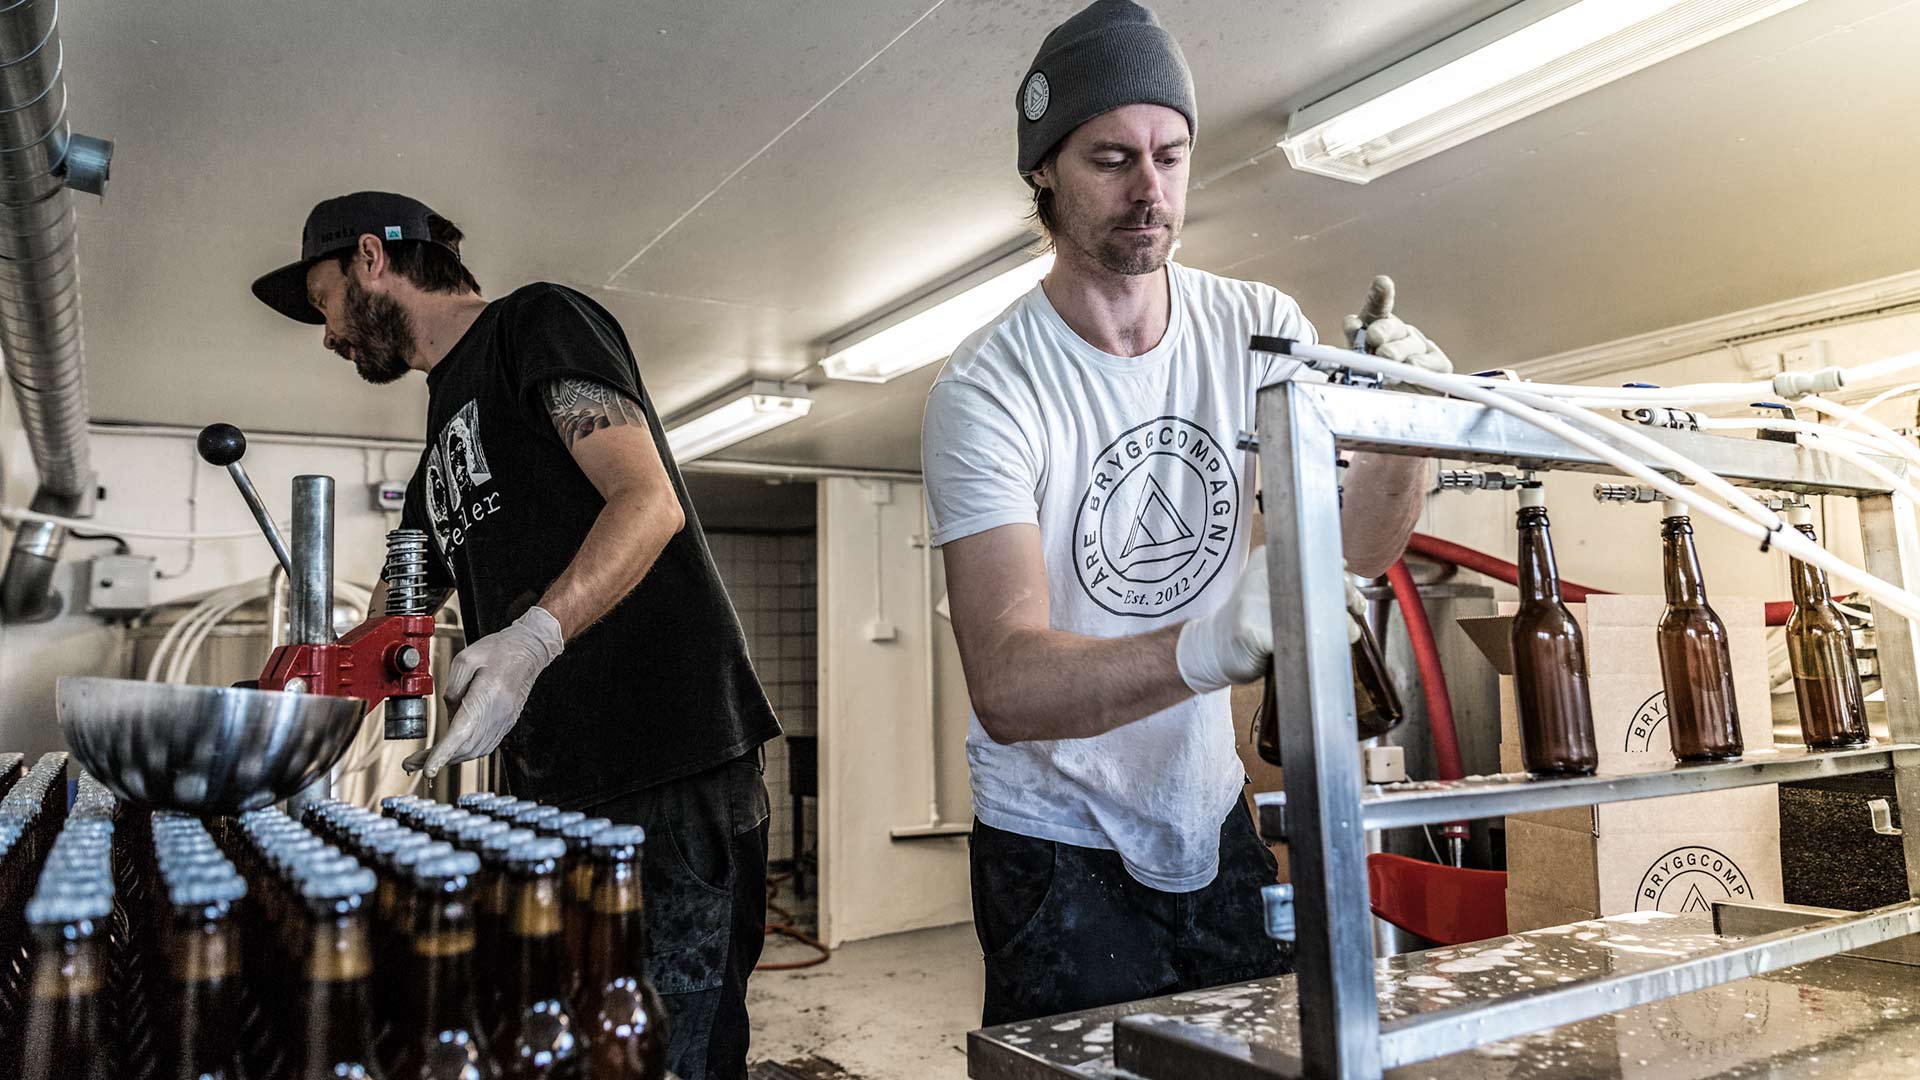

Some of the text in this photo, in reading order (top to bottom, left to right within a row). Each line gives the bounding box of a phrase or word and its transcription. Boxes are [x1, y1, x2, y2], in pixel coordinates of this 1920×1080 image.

[1089, 426, 1231, 557] BRYGGCOMPAGNI
[1123, 577, 1191, 606] Est. 2012
[1643, 852, 1745, 900] BRYGGCOMP
